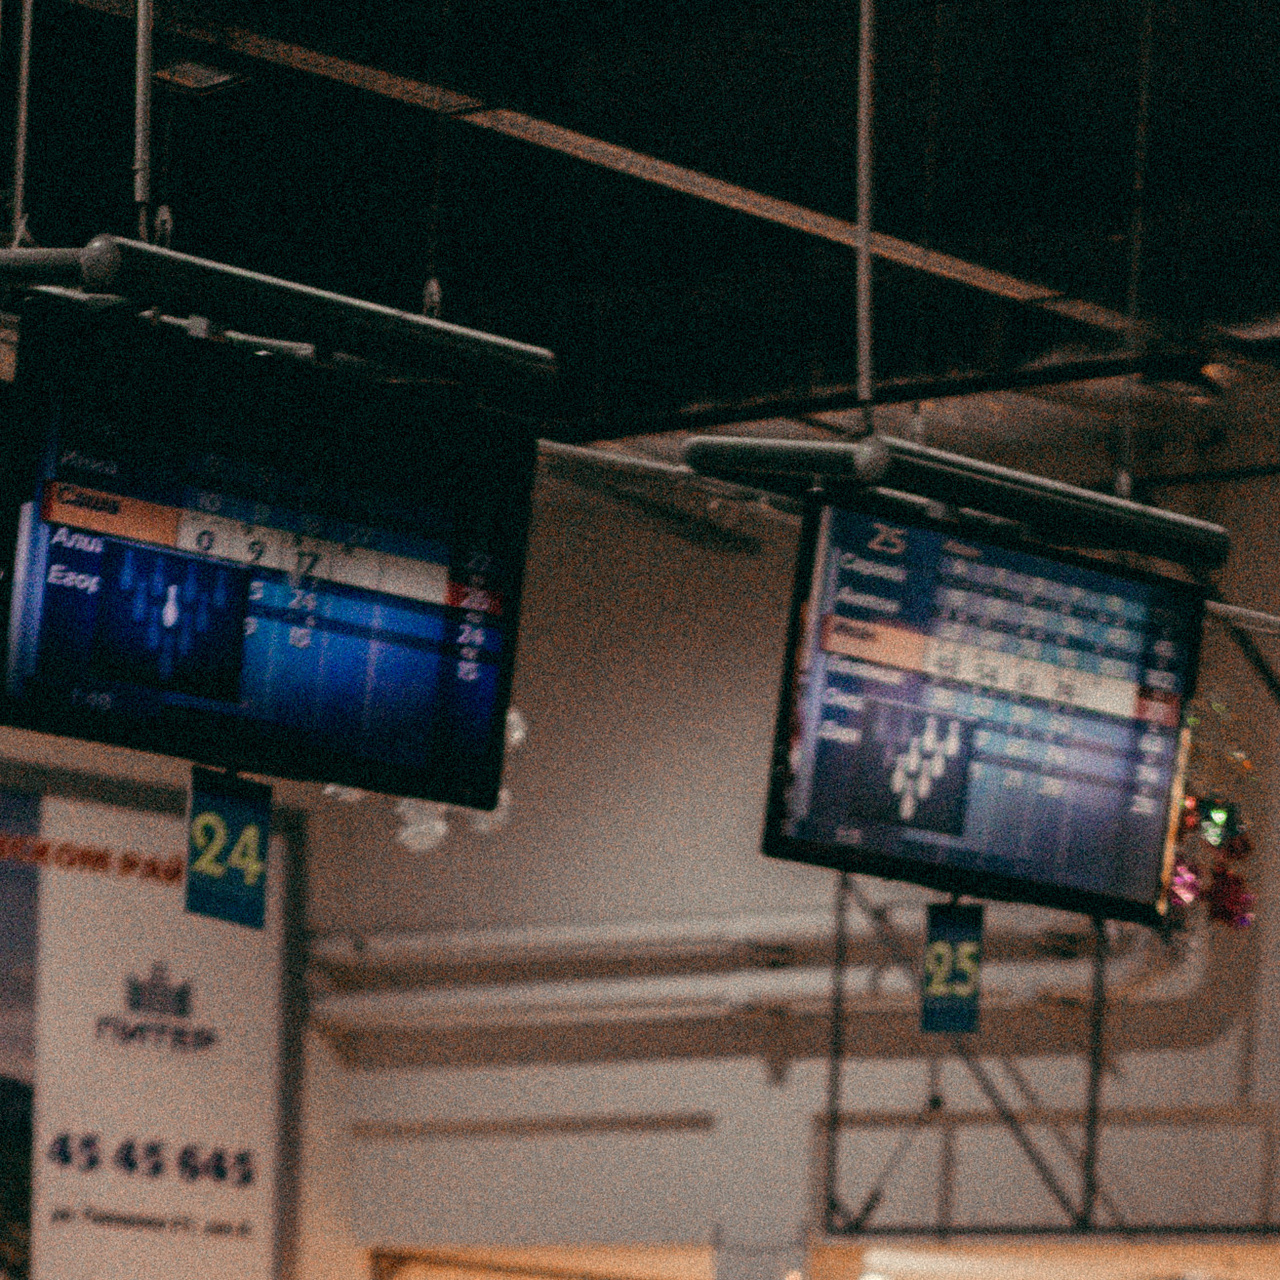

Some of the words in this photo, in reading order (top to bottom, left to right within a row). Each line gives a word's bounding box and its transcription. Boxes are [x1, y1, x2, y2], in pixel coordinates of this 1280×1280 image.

[867, 521, 908, 556] 25
[191, 811, 266, 886] 24
[925, 940, 981, 999] 25
[94, 1014, 218, 1053] ПИТЕР
[49, 1132, 100, 1174] 45
[114, 1140, 165, 1179] 45
[177, 1143, 255, 1187] 645
